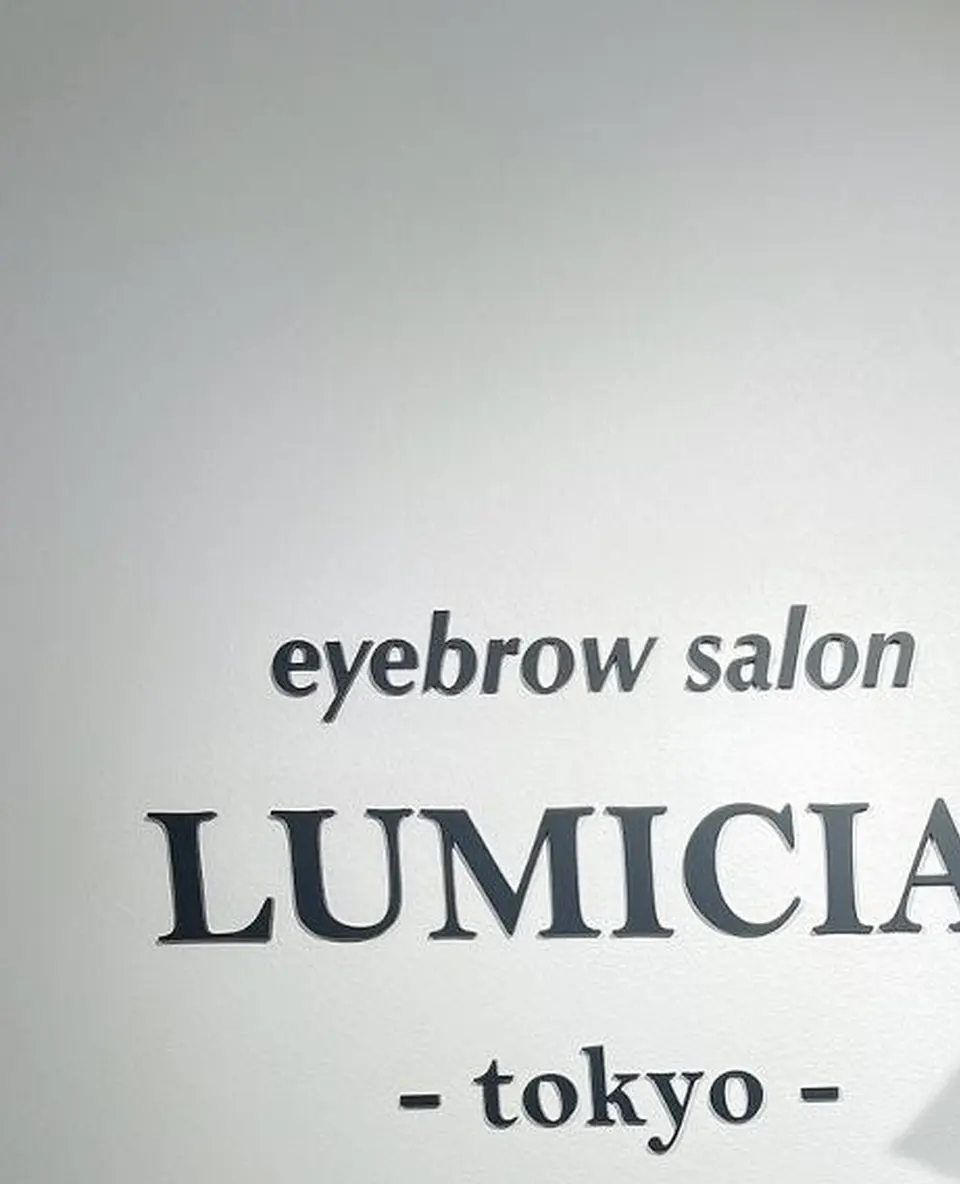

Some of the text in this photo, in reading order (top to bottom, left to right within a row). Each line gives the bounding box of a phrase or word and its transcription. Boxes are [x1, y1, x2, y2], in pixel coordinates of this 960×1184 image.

[270, 604, 917, 724] eyebrow salon
[472, 1044, 765, 1155] tokyo
